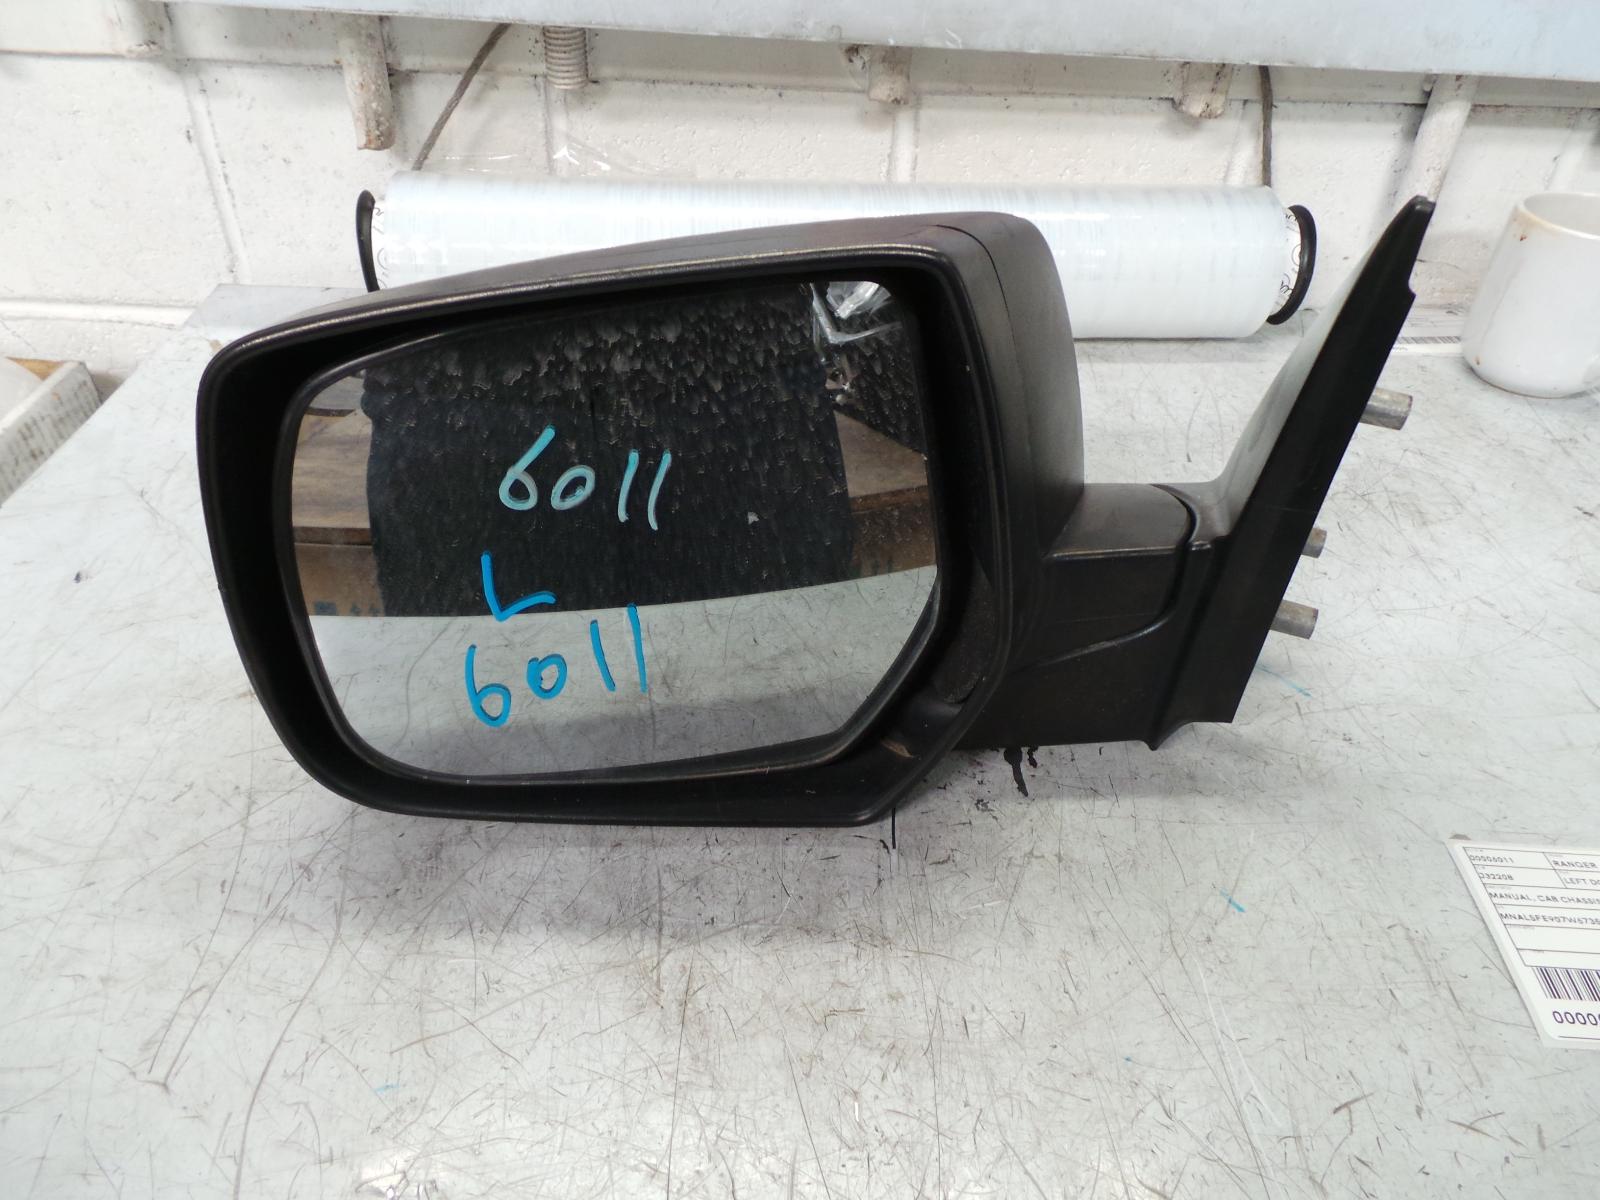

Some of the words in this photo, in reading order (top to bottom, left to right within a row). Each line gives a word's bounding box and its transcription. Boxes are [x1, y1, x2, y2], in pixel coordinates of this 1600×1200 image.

[499, 424, 672, 531] 6011
[480, 550, 557, 622] L
[464, 602, 648, 728] 6011
[1553, 860, 1598, 869] RANGER
[1563, 877, 1587, 886] LEFT
[1538, 895, 1559, 903] CAB
[1552, 1010, 1600, 1026] 0000
